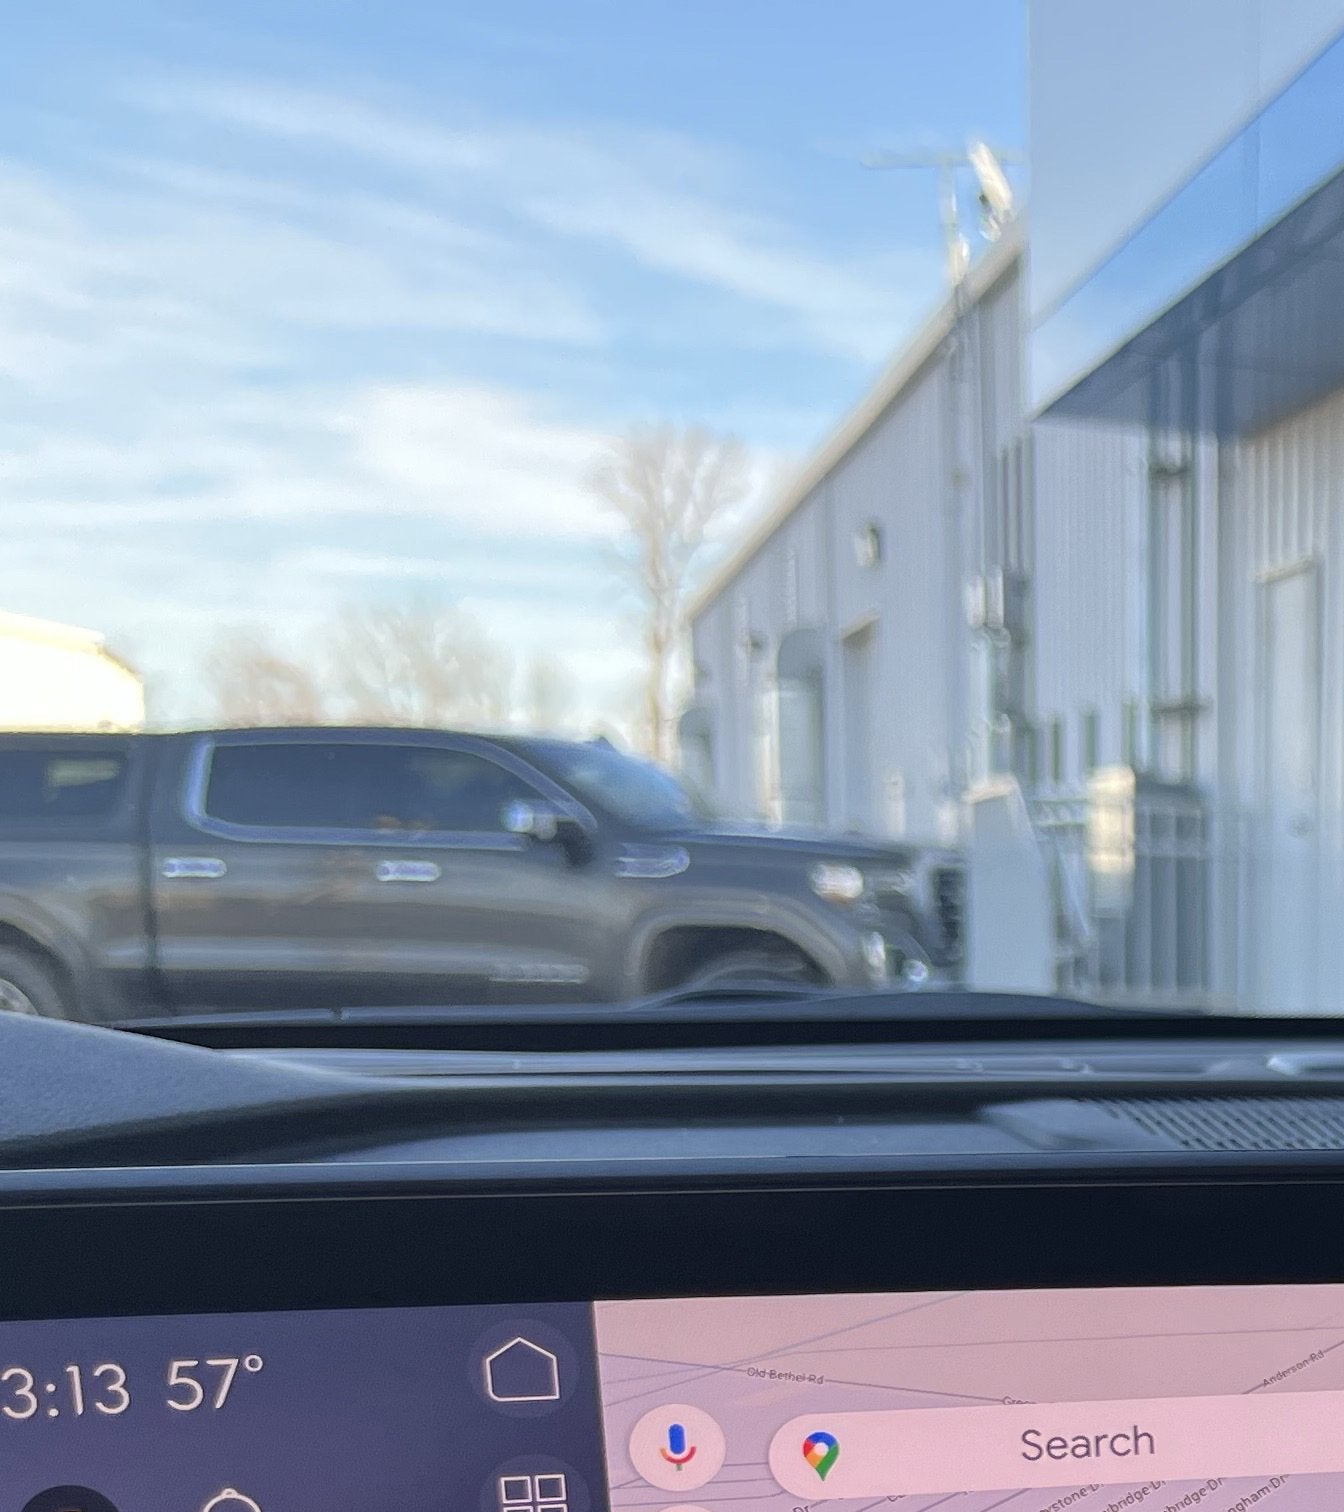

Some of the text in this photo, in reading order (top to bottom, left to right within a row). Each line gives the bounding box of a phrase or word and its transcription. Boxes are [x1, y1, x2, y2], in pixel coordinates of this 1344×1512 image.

[808, 1374, 824, 1385] Rd
[1263, 1350, 1325, 1387] Anderson Rd
[1, 1354, 263, 1419] 3:13 57°
[1020, 1424, 1156, 1463] Search
[1206, 1477, 1224, 1492] Dr
[1270, 1474, 1288, 1490] Dr
